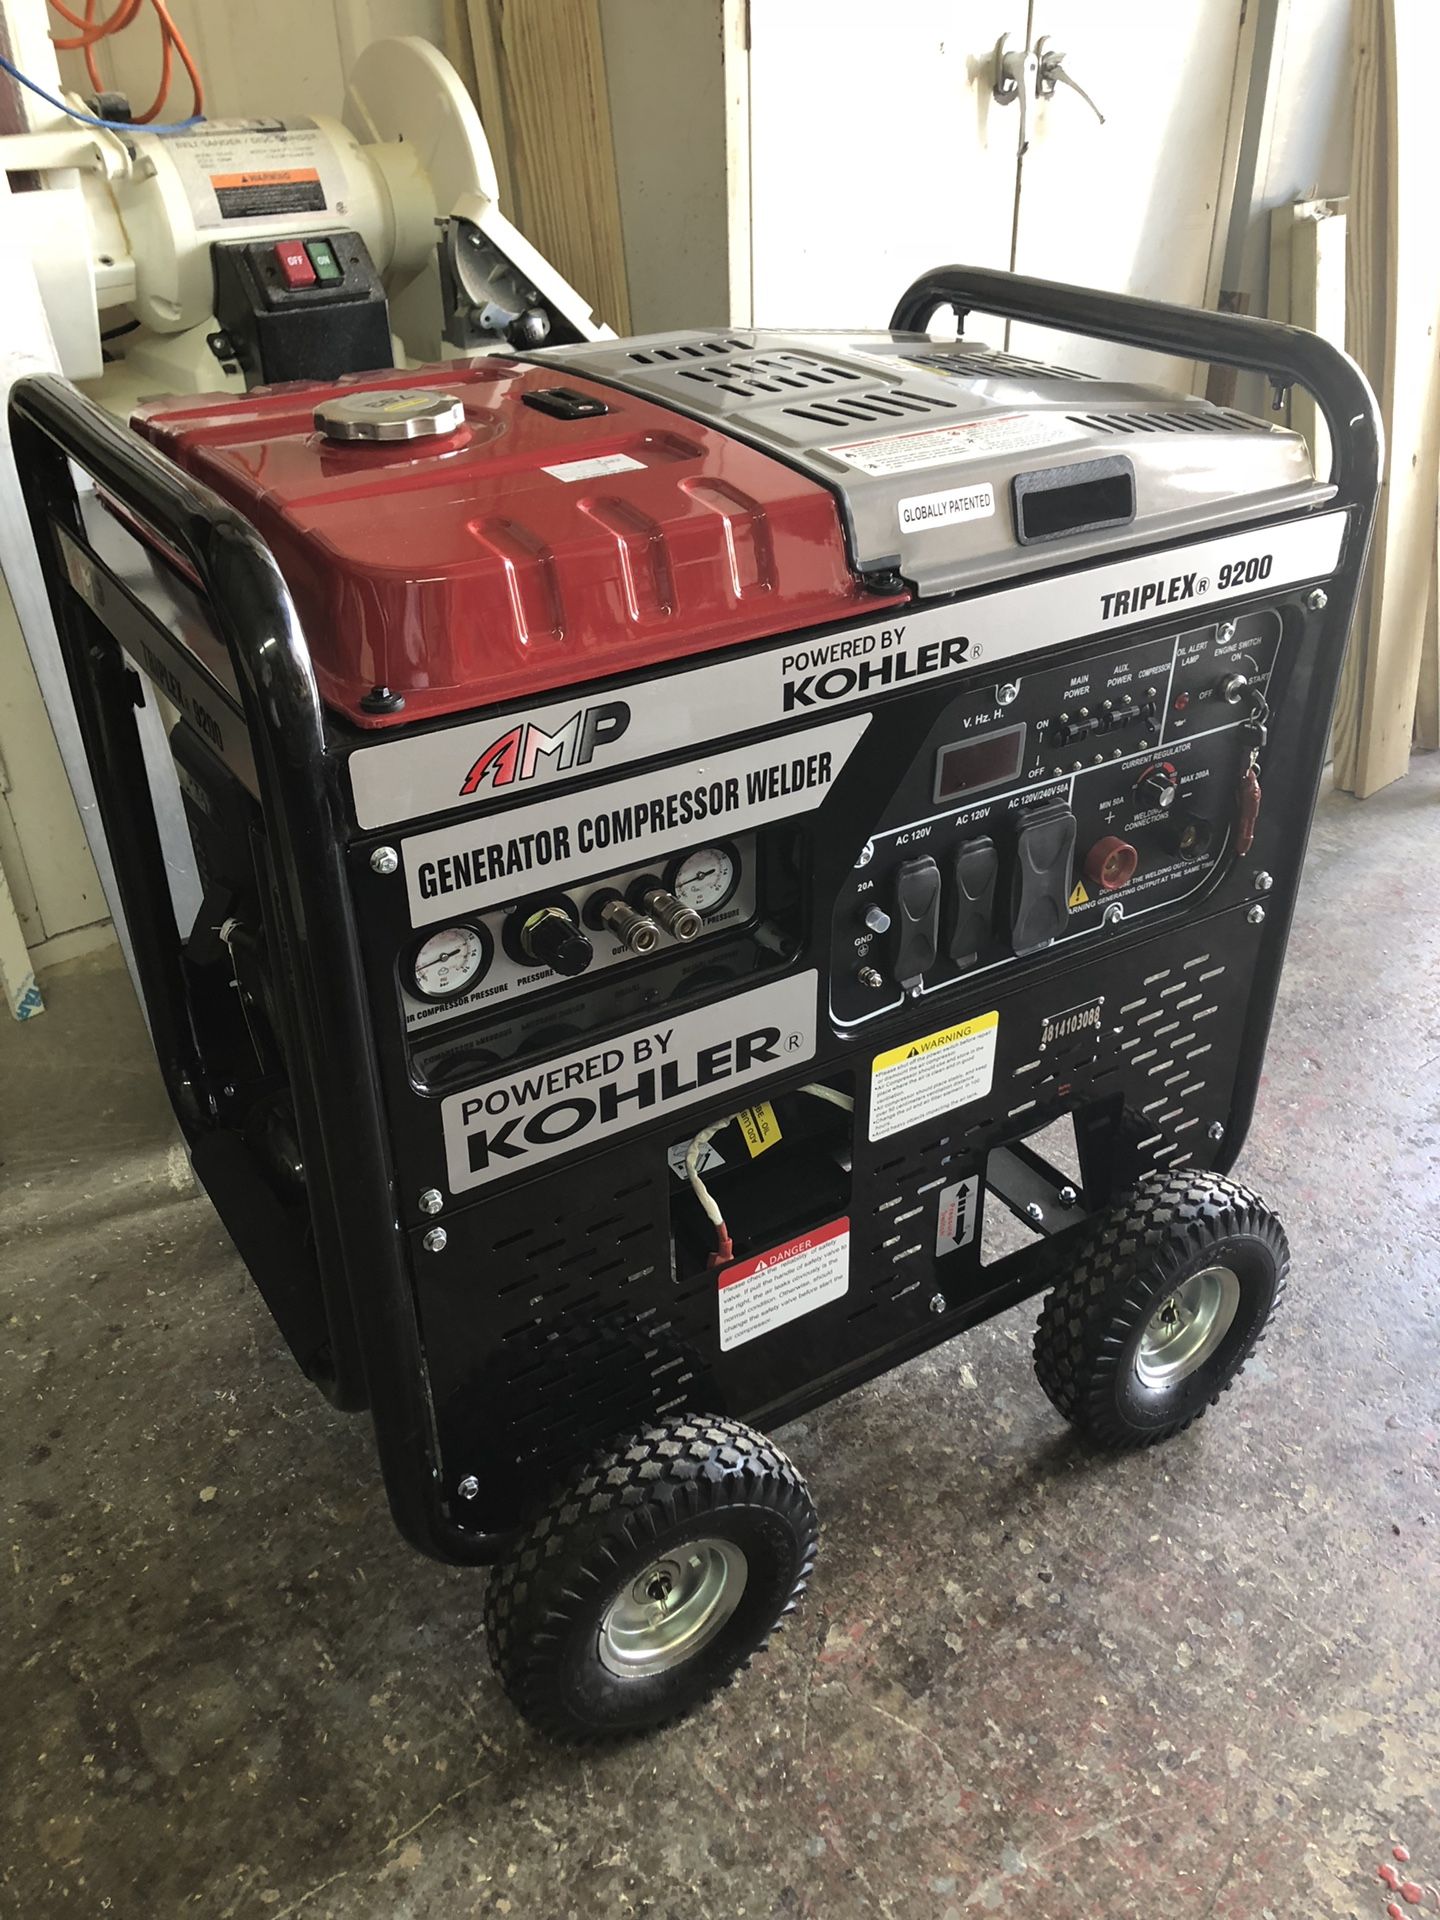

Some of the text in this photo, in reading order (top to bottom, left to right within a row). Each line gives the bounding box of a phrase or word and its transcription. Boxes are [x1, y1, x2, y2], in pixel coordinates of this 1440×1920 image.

[287, 255, 304, 266] OFF
[317, 255, 331, 265] ON
[903, 493, 990, 523] GLOBALLY PATENTED
[1218, 554, 1273, 590] 9200
[782, 626, 906, 675] POWERED BY
[1176, 641, 1208, 657] OIL ALERT
[1214, 637, 1262, 657] ENGINE SWITCH
[1181, 654, 1200, 667] LAMP
[1231, 652, 1242, 662] ON
[1138, 662, 1172, 679] COMPRESSOR
[1248, 671, 1271, 685] START
[1070, 674, 1089, 687] MAIN
[1106, 674, 1133, 688] POWER
[1063, 685, 1091, 700] POWER
[1199, 689, 1214, 700] OFF
[1036, 719, 1049, 730] ON
[459, 700, 631, 796] AMP
[1121, 742, 1192, 771] CURRENT REGULATOR
[1028, 767, 1045, 779] OFF
[1180, 774, 1195, 785] MAX
[1195, 769, 1210, 780] 200A
[1007, 798, 1020, 809] AC
[1056, 782, 1069, 796] 50A
[1099, 796, 1124, 810] MIN 50A
[955, 807, 991, 827] AC 120V
[1124, 810, 1169, 832] CONNECTIONS
[1133, 808, 1163, 821] WELDIN
[418, 750, 832, 900] GENERATOR COMPRESSOR WELDER
[895, 826, 932, 846] AC 120V
[1132, 875, 1144, 884] THE
[1145, 865, 1172, 880] WELDING
[857, 880, 874, 892] 20A
[1068, 899, 1096, 915] ARNING
[1097, 886, 1136, 905] GENERATING
[1137, 878, 1160, 892] OUTPUT
[1160, 875, 1169, 884] AT
[1170, 871, 1182, 880] THE
[1183, 864, 1200, 876] SAME
[1201, 859, 1215, 870] TIME
[707, 908, 740, 924] PRESSURE
[854, 933, 873, 947] GND
[517, 968, 554, 986] PRESSURE
[416, 995, 470, 1019] COMPRESSOR
[471, 982, 509, 1002] PRESSURE
[1041, 1005, 1101, 1043] 4814103088
[920, 1026, 972, 1052] WARNING
[461, 1029, 674, 1126] POWERED BY
[748, 1127, 758, 1144] ADD
[769, 1239, 812, 1265] DANGER
[723, 1281, 745, 1294] Please
[747, 1270, 765, 1283] check
[767, 1266, 776, 1274] the
[781, 1252, 807, 1268] reliability
[818, 1239, 836, 1251] safety
[749, 1282, 761, 1293] pull
[762, 1278, 772, 1286] the
[774, 1268, 794, 1281] handle
[804, 1255, 821, 1267] safety
[824, 1247, 839, 1258] valve
[724, 1305, 733, 1314] the
[753, 1292, 763, 1300] the
[774, 1279, 790, 1290] leaks
[792, 1266, 819, 1282] obviously
[828, 1257, 837, 1265] the
[724, 1308, 745, 1323] normal
[813, 1268, 832, 1282] should
[724, 1274, 843, 1333] change the safety valve before start the
